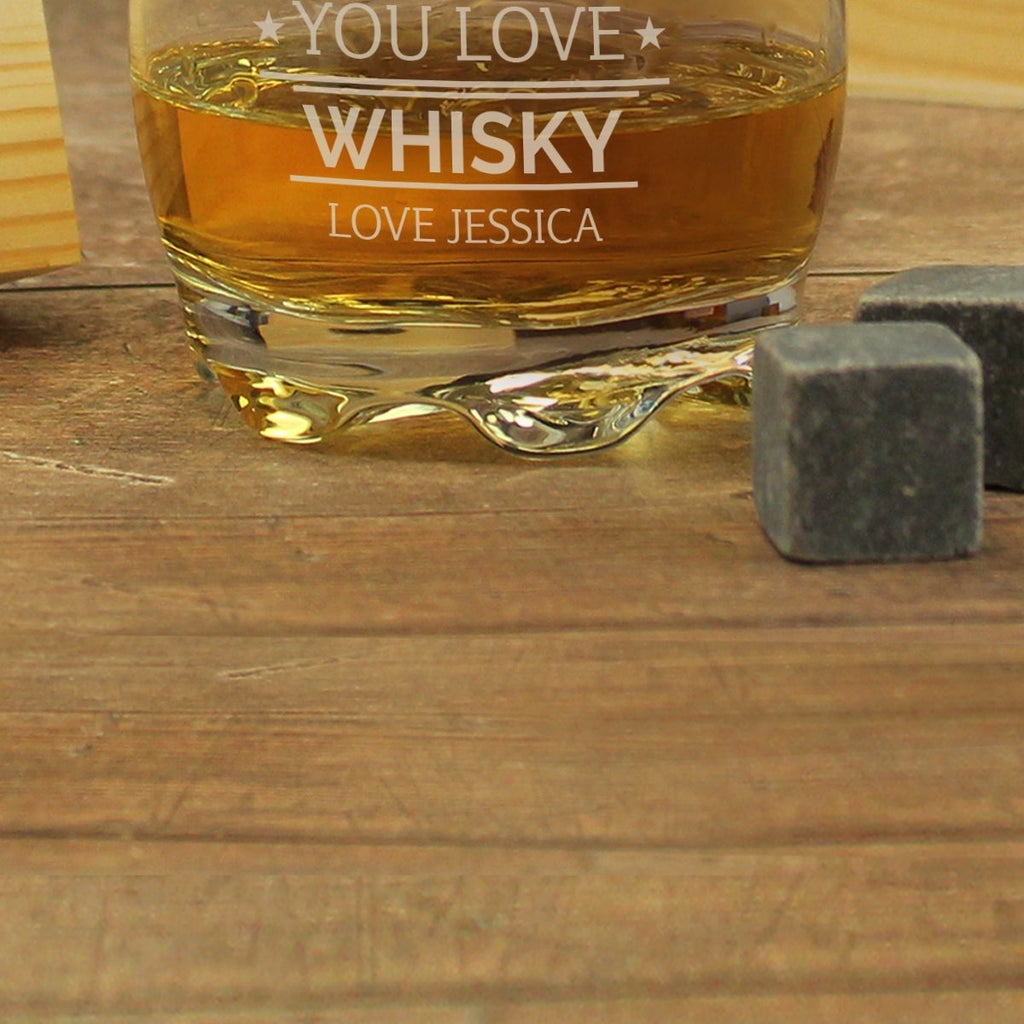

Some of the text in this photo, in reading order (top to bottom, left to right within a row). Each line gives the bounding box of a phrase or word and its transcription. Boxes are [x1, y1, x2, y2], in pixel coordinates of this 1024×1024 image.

[292, 1, 625, 63] YOU LOVE
[302, 104, 622, 175] WHISKY
[328, 202, 603, 245] LOVE JESSICA
